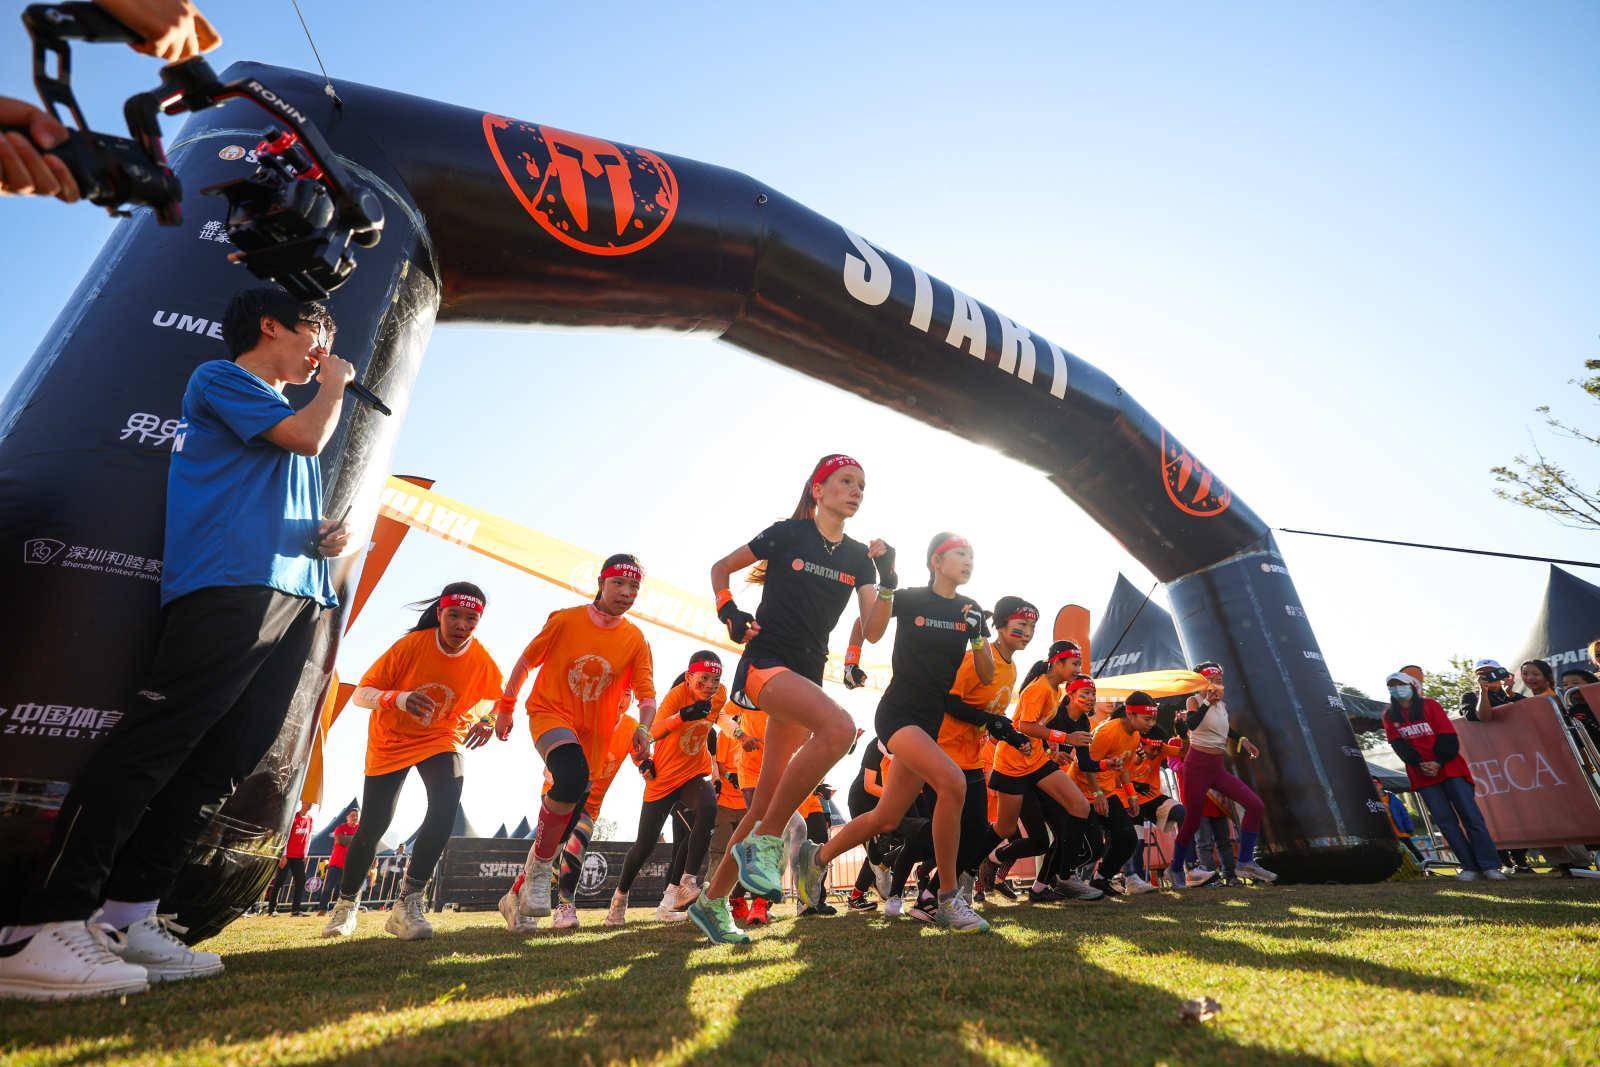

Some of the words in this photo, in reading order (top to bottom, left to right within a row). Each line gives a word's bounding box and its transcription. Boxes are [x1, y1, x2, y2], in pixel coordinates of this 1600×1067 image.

[248, 81, 306, 124] RONIN
[843, 227, 1068, 400] START
[62, 560, 103, 572] Shenzhen
[105, 566, 133, 577] United
[66, 545, 163, 573] 深圳和睦家
[804, 561, 839, 581] SPARTAN
[839, 571, 856, 586] KIDS
[926, 618, 954, 631] SPARTAN
[10, 703, 124, 729] 中国体育
[4, 724, 109, 740] ZHIBO.T
[1469, 751, 1567, 798] SECA
